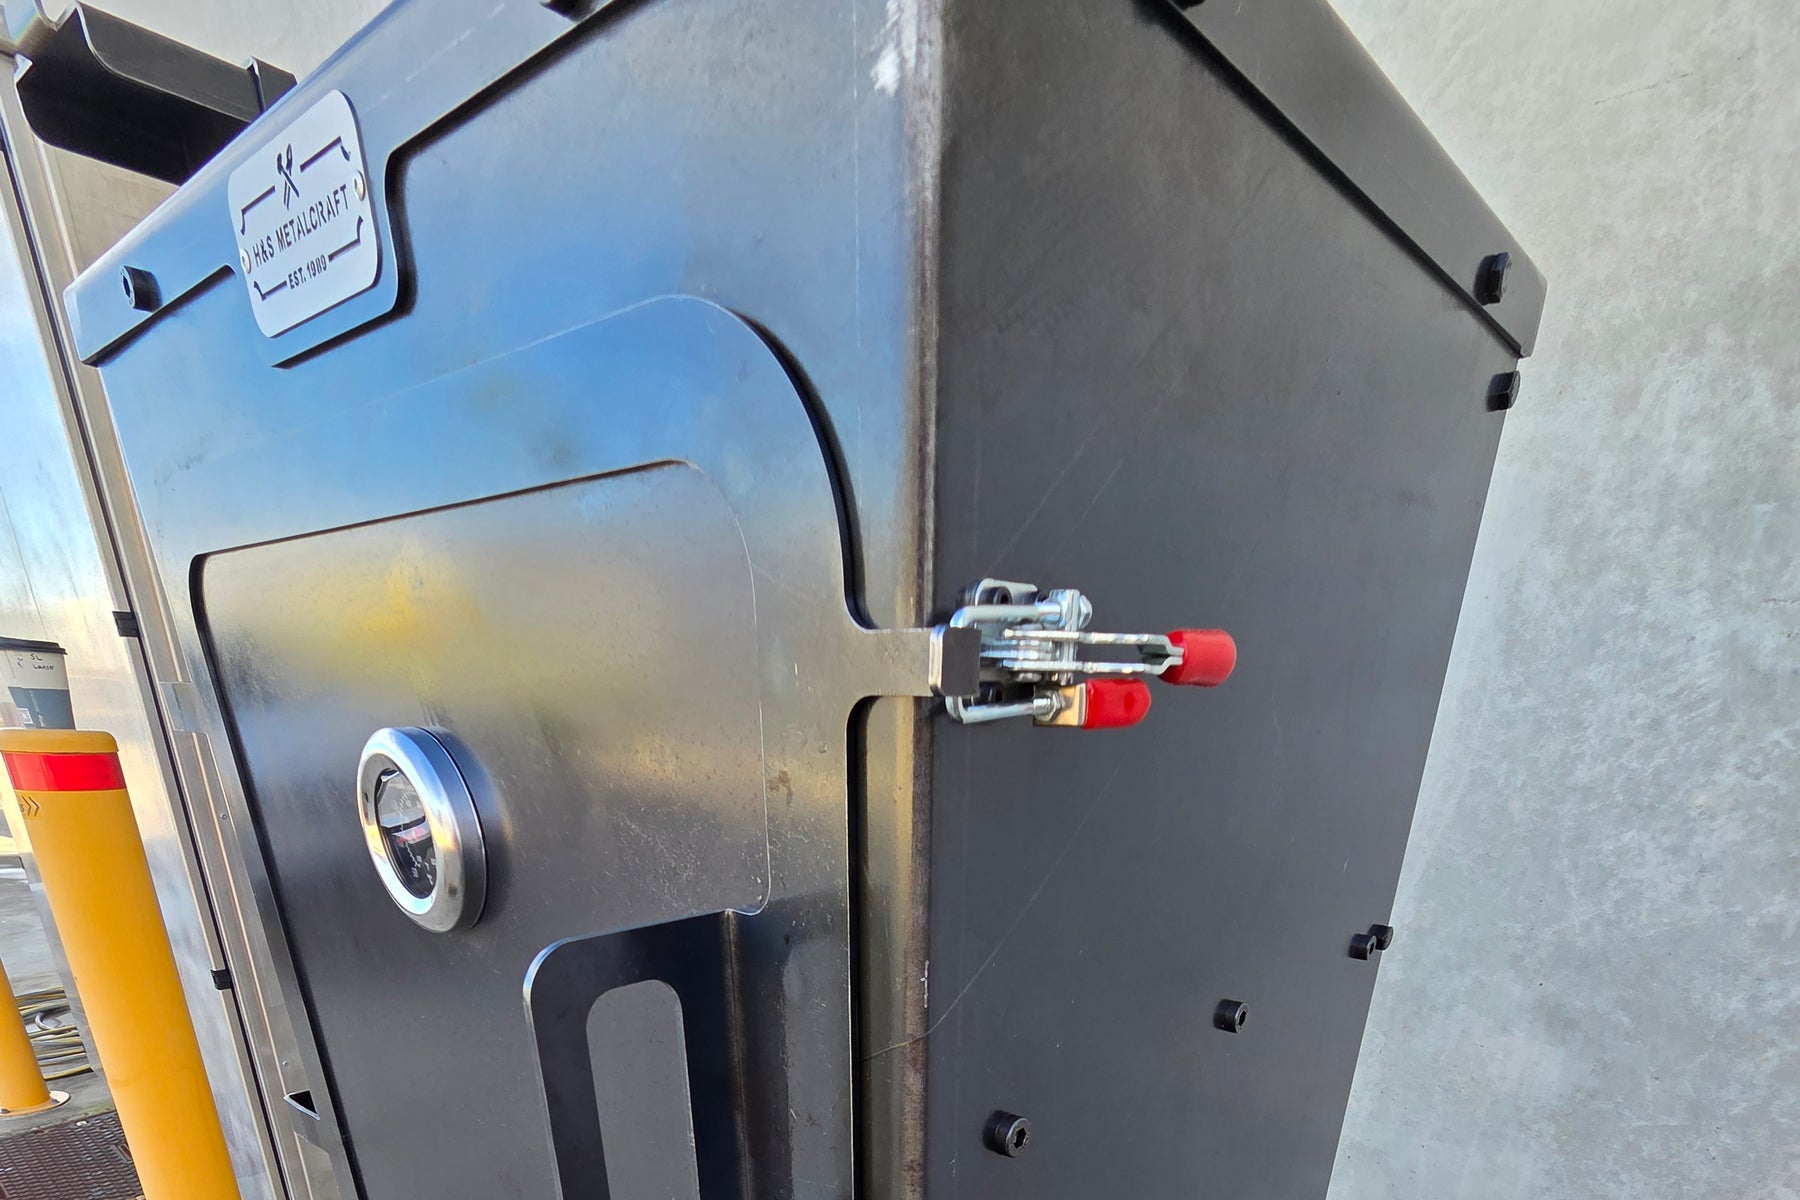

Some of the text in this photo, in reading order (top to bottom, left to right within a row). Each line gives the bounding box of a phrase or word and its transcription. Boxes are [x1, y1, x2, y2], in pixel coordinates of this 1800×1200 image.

[252, 183, 349, 268] H&S METALCRAFT
[287, 266, 307, 290] EST.
